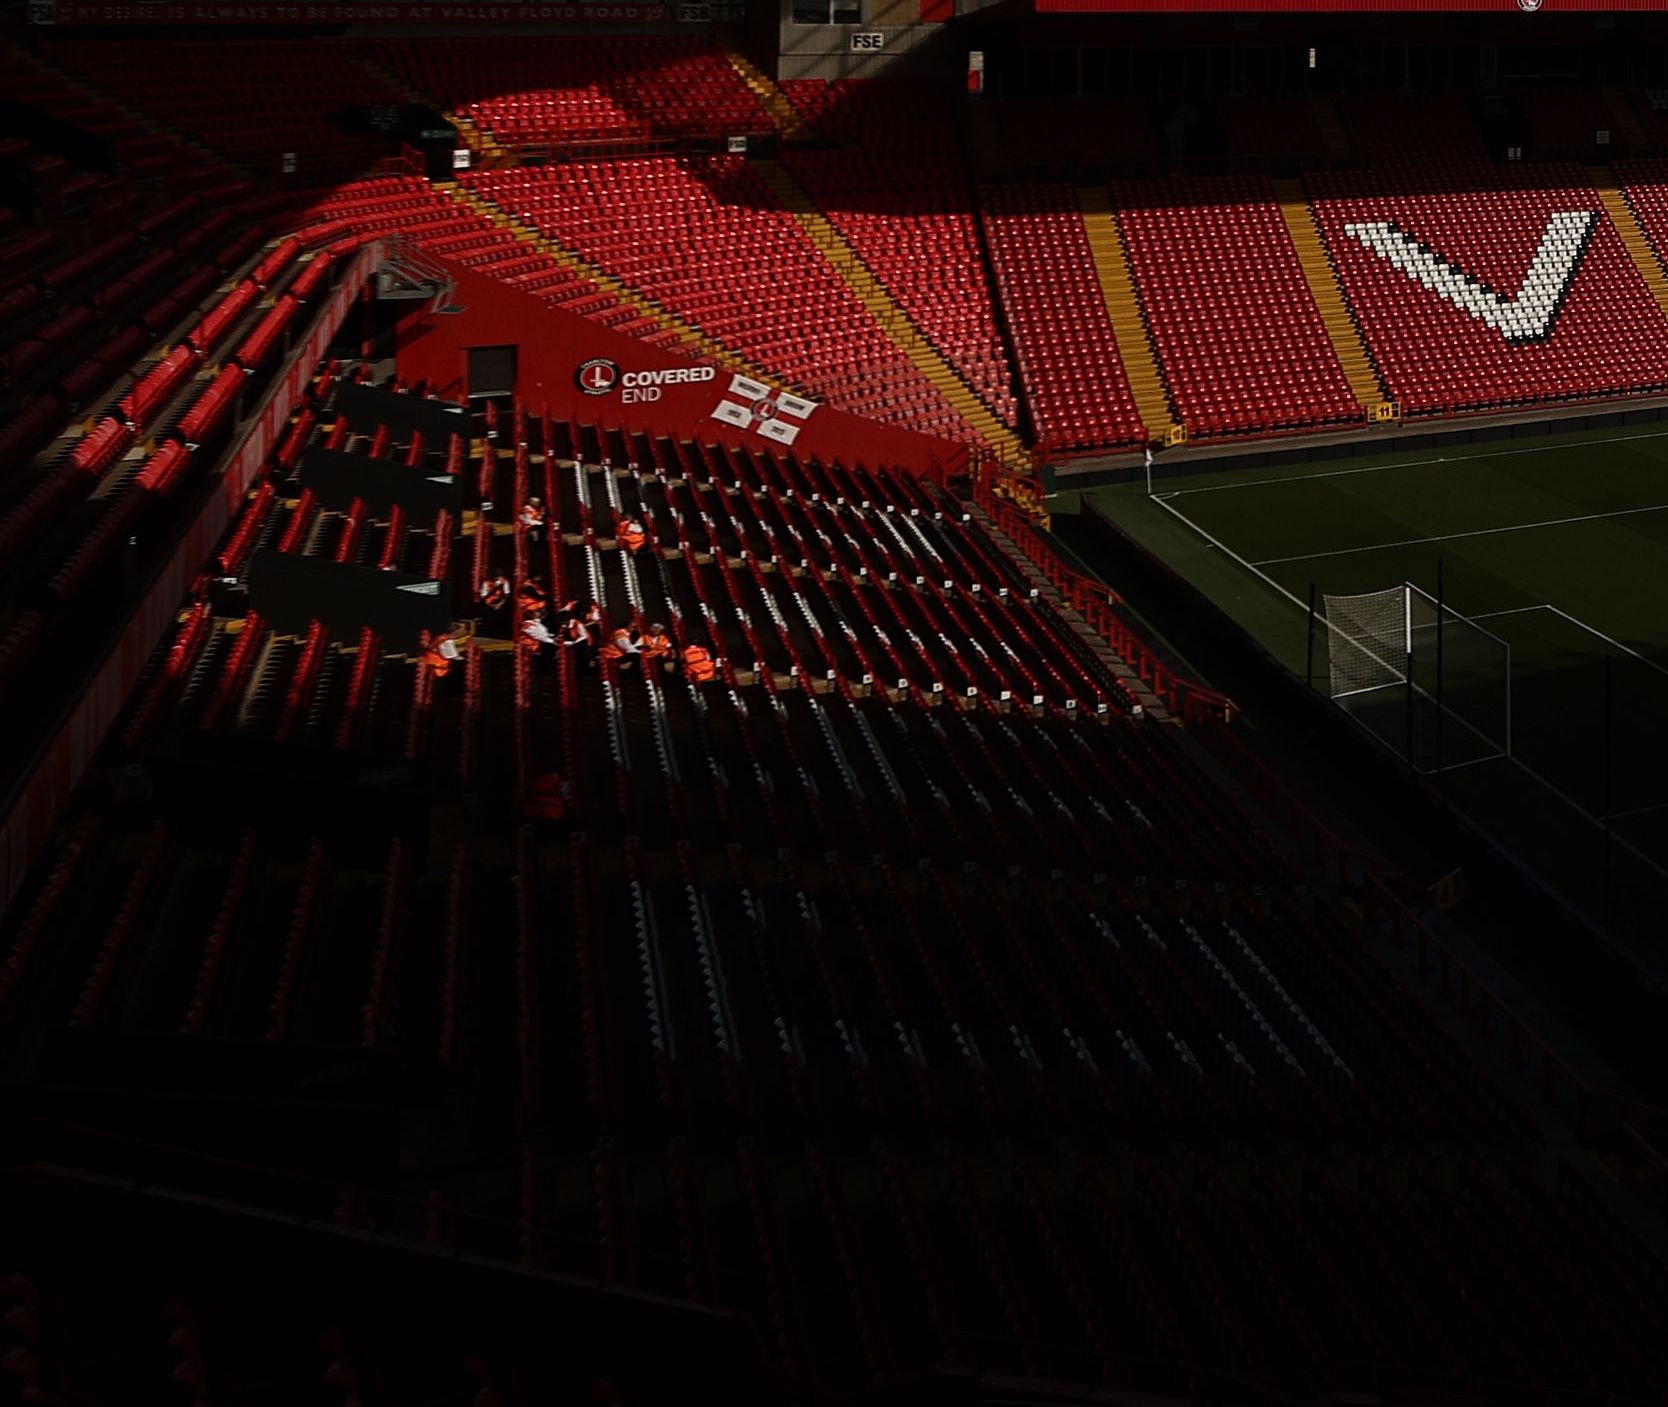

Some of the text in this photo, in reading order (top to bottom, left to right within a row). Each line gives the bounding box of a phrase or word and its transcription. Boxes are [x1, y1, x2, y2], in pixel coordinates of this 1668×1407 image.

[193, 6, 268, 19] ALWAYS
[275, 6, 298, 19] TO
[306, 6, 328, 19] BE
[334, 6, 399, 19] FOUND
[408, 6, 433, 19] AT
[440, 6, 510, 19] VALLEY
[519, 6, 576, 19] FLOYD
[583, 6, 638, 19] ROAD
[683, 6, 710, 20] FSB
[853, 35, 881, 49] FSE
[621, 366, 717, 388] COVERED
[621, 386, 663, 405] END
